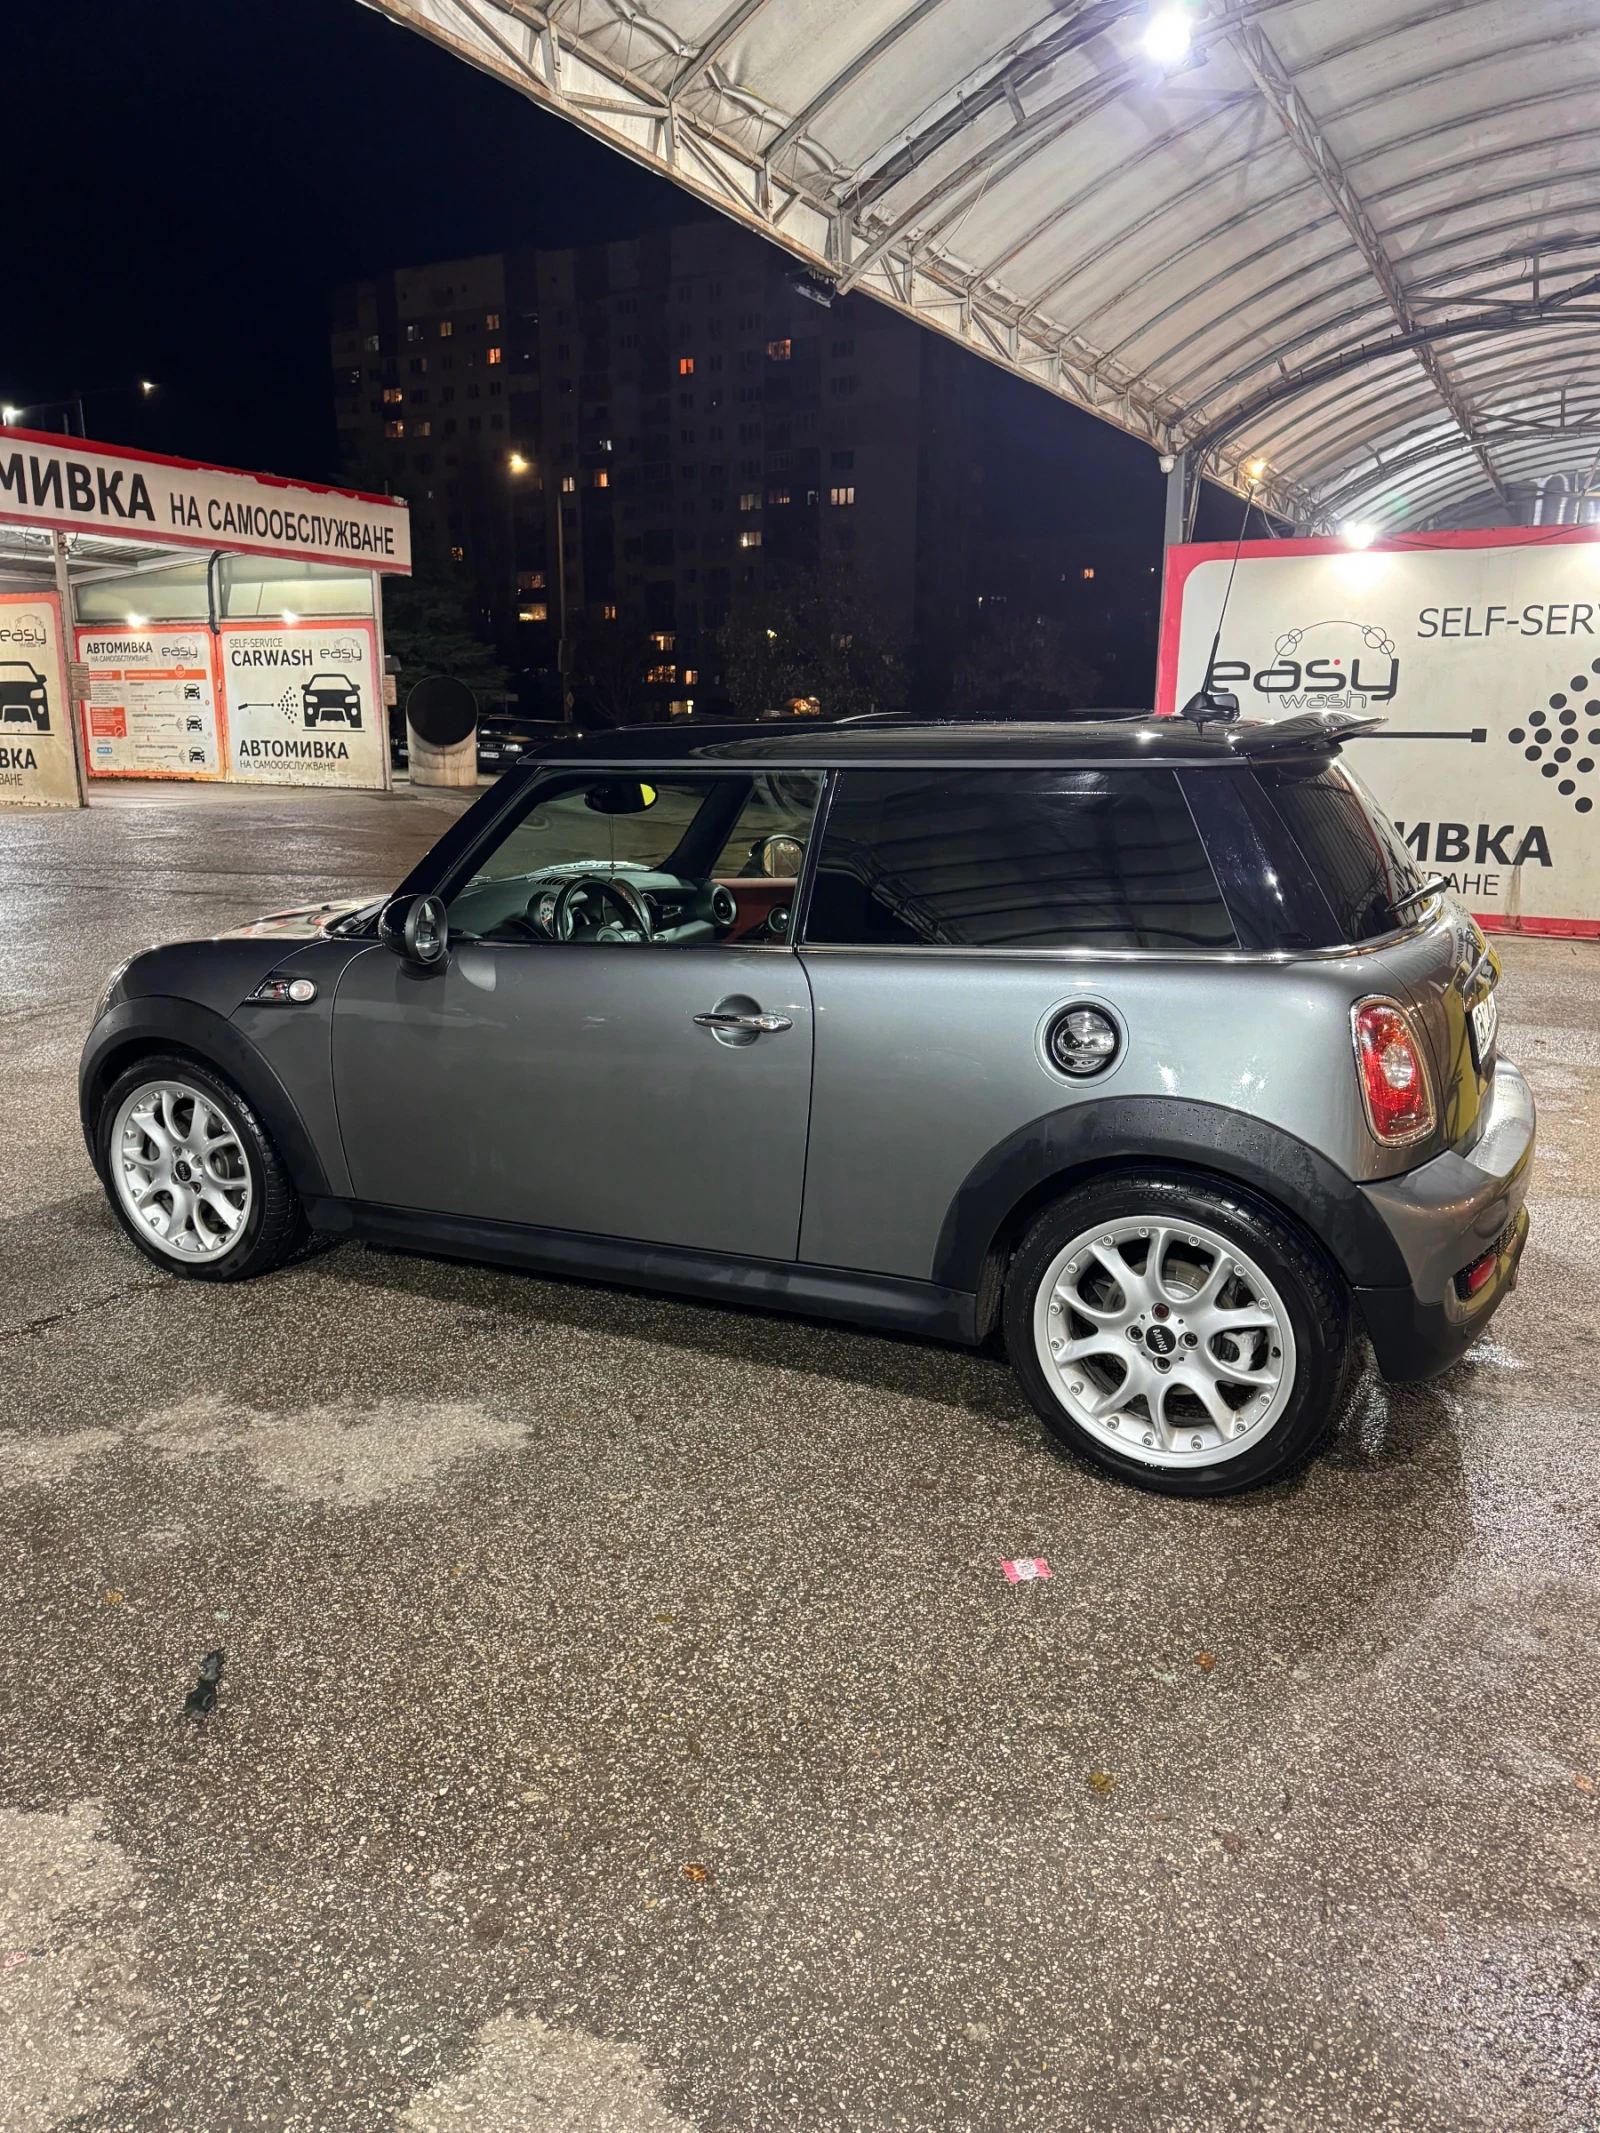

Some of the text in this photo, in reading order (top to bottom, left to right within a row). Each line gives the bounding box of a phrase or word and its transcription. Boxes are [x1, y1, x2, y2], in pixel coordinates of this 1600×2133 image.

[170, 492, 202, 528] НА
[208, 499, 395, 555] САМООБСЛУЖВАНЕ
[1417, 604, 1600, 638] SELF-SER
[0, 628, 47, 645] easy
[230, 638, 283, 648] SELF-SERVICE
[86, 641, 153, 655] АВТОМИВКА
[161, 647, 198, 659] easy
[320, 648, 362, 661] easy
[231, 649, 313, 667] CARWASH
[1208, 658, 1400, 701] easy
[1279, 690, 1367, 709] wash
[239, 739, 349, 760] АВТОМИВКА
[240, 760, 336, 772] НА САМООБСЛУЖВАНЕ
[1152, 1329, 1168, 1351] MINI
